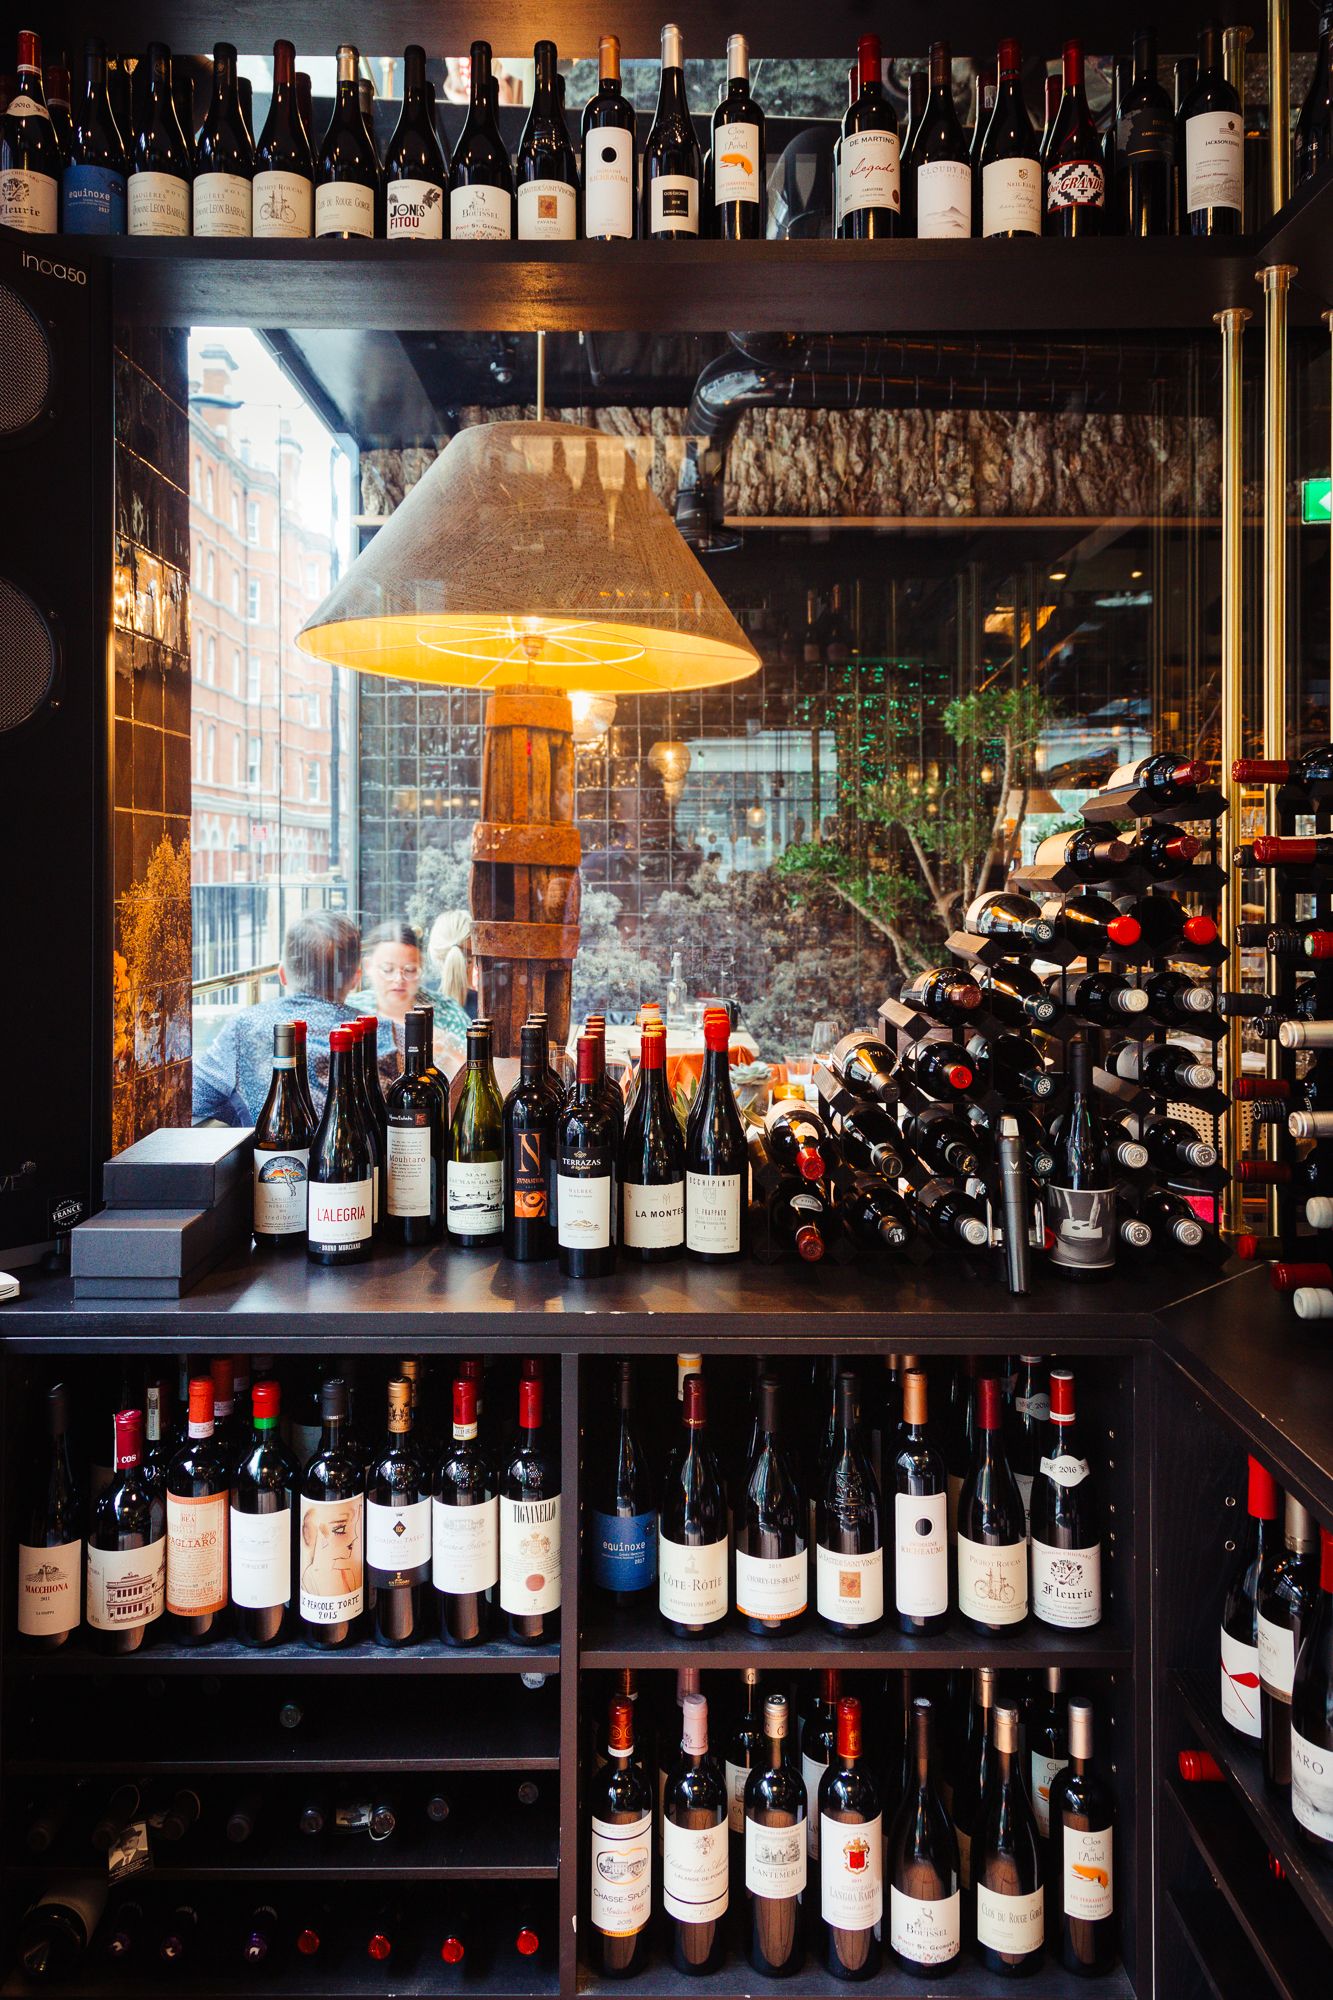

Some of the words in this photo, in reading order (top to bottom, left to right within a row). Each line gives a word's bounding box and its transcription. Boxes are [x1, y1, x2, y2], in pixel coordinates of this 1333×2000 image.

[861, 135, 895, 146] MARTINO
[849, 157, 895, 179] Legado
[921, 166, 958, 177] CLOUDY
[69, 188, 111, 201] equinoxe
[390, 203, 425, 218] JONES
[390, 216, 420, 230] FITOU
[389, 1154, 426, 1165] Mouhtaro
[518, 1133, 542, 1176] N
[562, 1157, 601, 1166] TERRAZAS
[689, 1176, 736, 1187] OCCHIPINTI
[52, 1204, 81, 1221] FRANCE
[317, 1205, 366, 1222] L'ALEGRIA
[635, 1209, 647, 1218] LA
[121, 1454, 137, 1464] COS
[1058, 1466, 1077, 1474] 2016
[513, 1501, 556, 1524] TIGNANELLO
[602, 1541, 646, 1552] equinoxe
[25, 1582, 68, 1594] MACCHIONA
[1042, 1581, 1093, 1600] Fleurie
[307, 1599, 334, 1611] PERGOLE
[337, 1594, 360, 1609] TORTE
[318, 1611, 338, 1620] 2015
[1083, 1837, 1102, 1846] Clos
